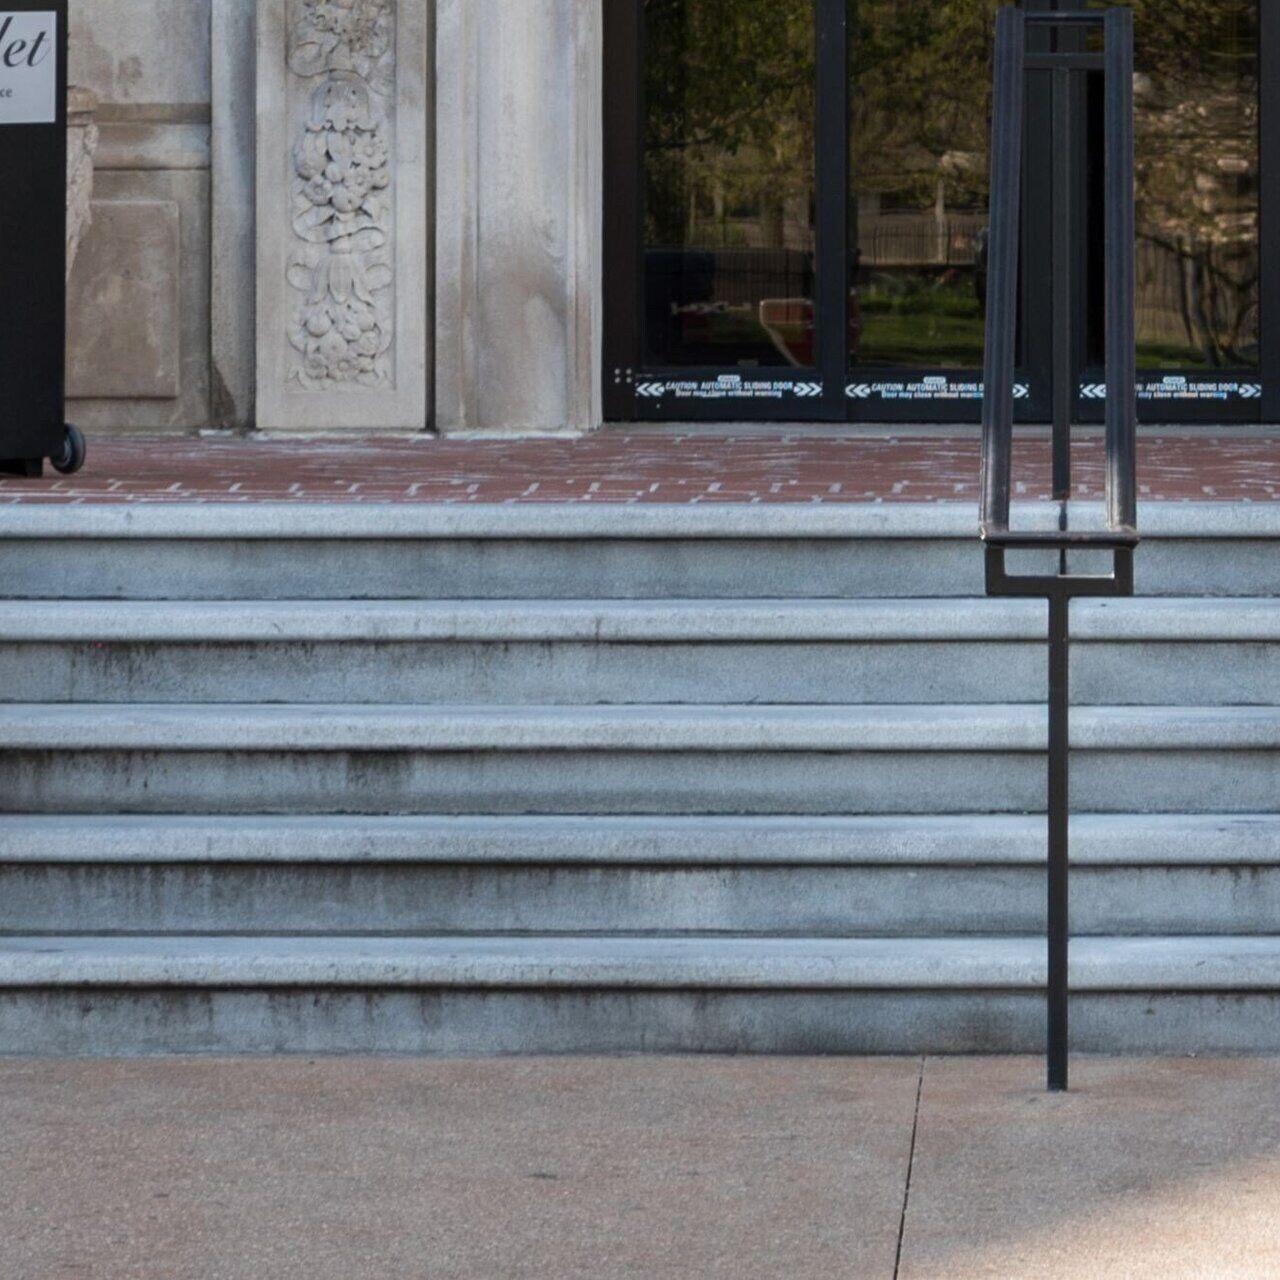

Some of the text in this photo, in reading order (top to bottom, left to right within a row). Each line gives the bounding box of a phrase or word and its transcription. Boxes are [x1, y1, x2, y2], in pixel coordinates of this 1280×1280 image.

[700, 381, 741, 391] AUTOMATIC
[907, 382, 948, 392] AUTOMATIC
[1146, 382, 1187, 392] AUTOMATIC
